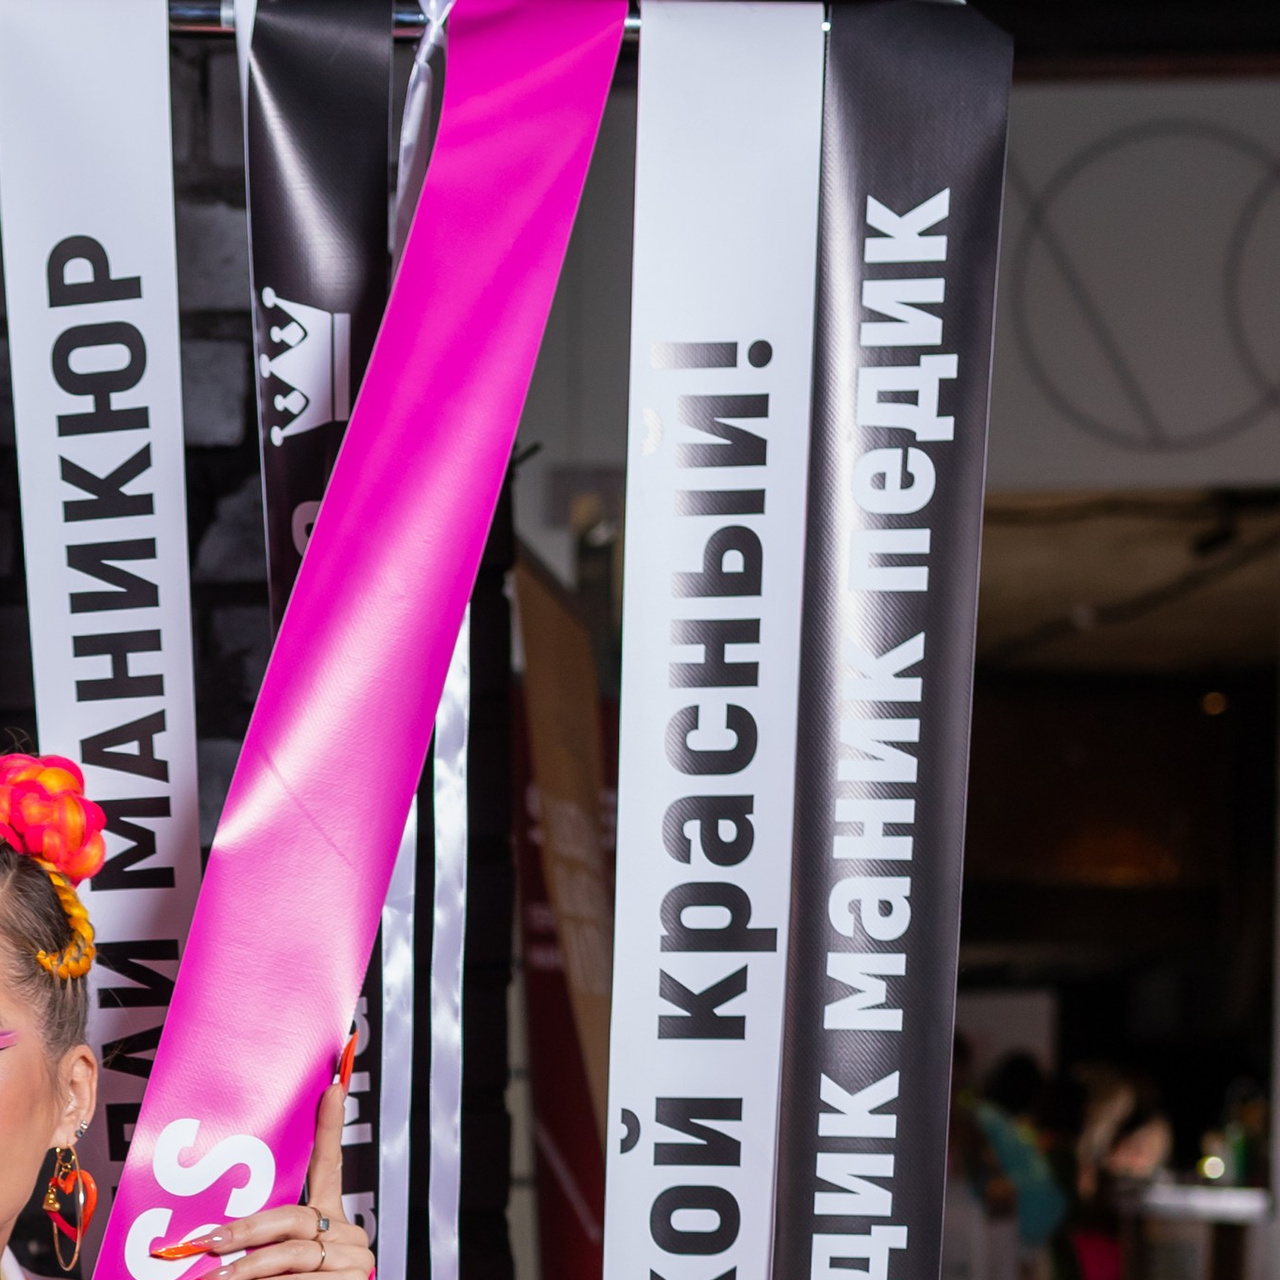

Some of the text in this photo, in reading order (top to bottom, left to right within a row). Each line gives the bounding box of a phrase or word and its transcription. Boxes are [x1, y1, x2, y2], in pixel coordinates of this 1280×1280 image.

[46, 234, 176, 891] МАНИКЮР
[847, 187, 959, 592] педик
[640, 339, 777, 1040] красный!
[823, 631, 925, 1031] маник
